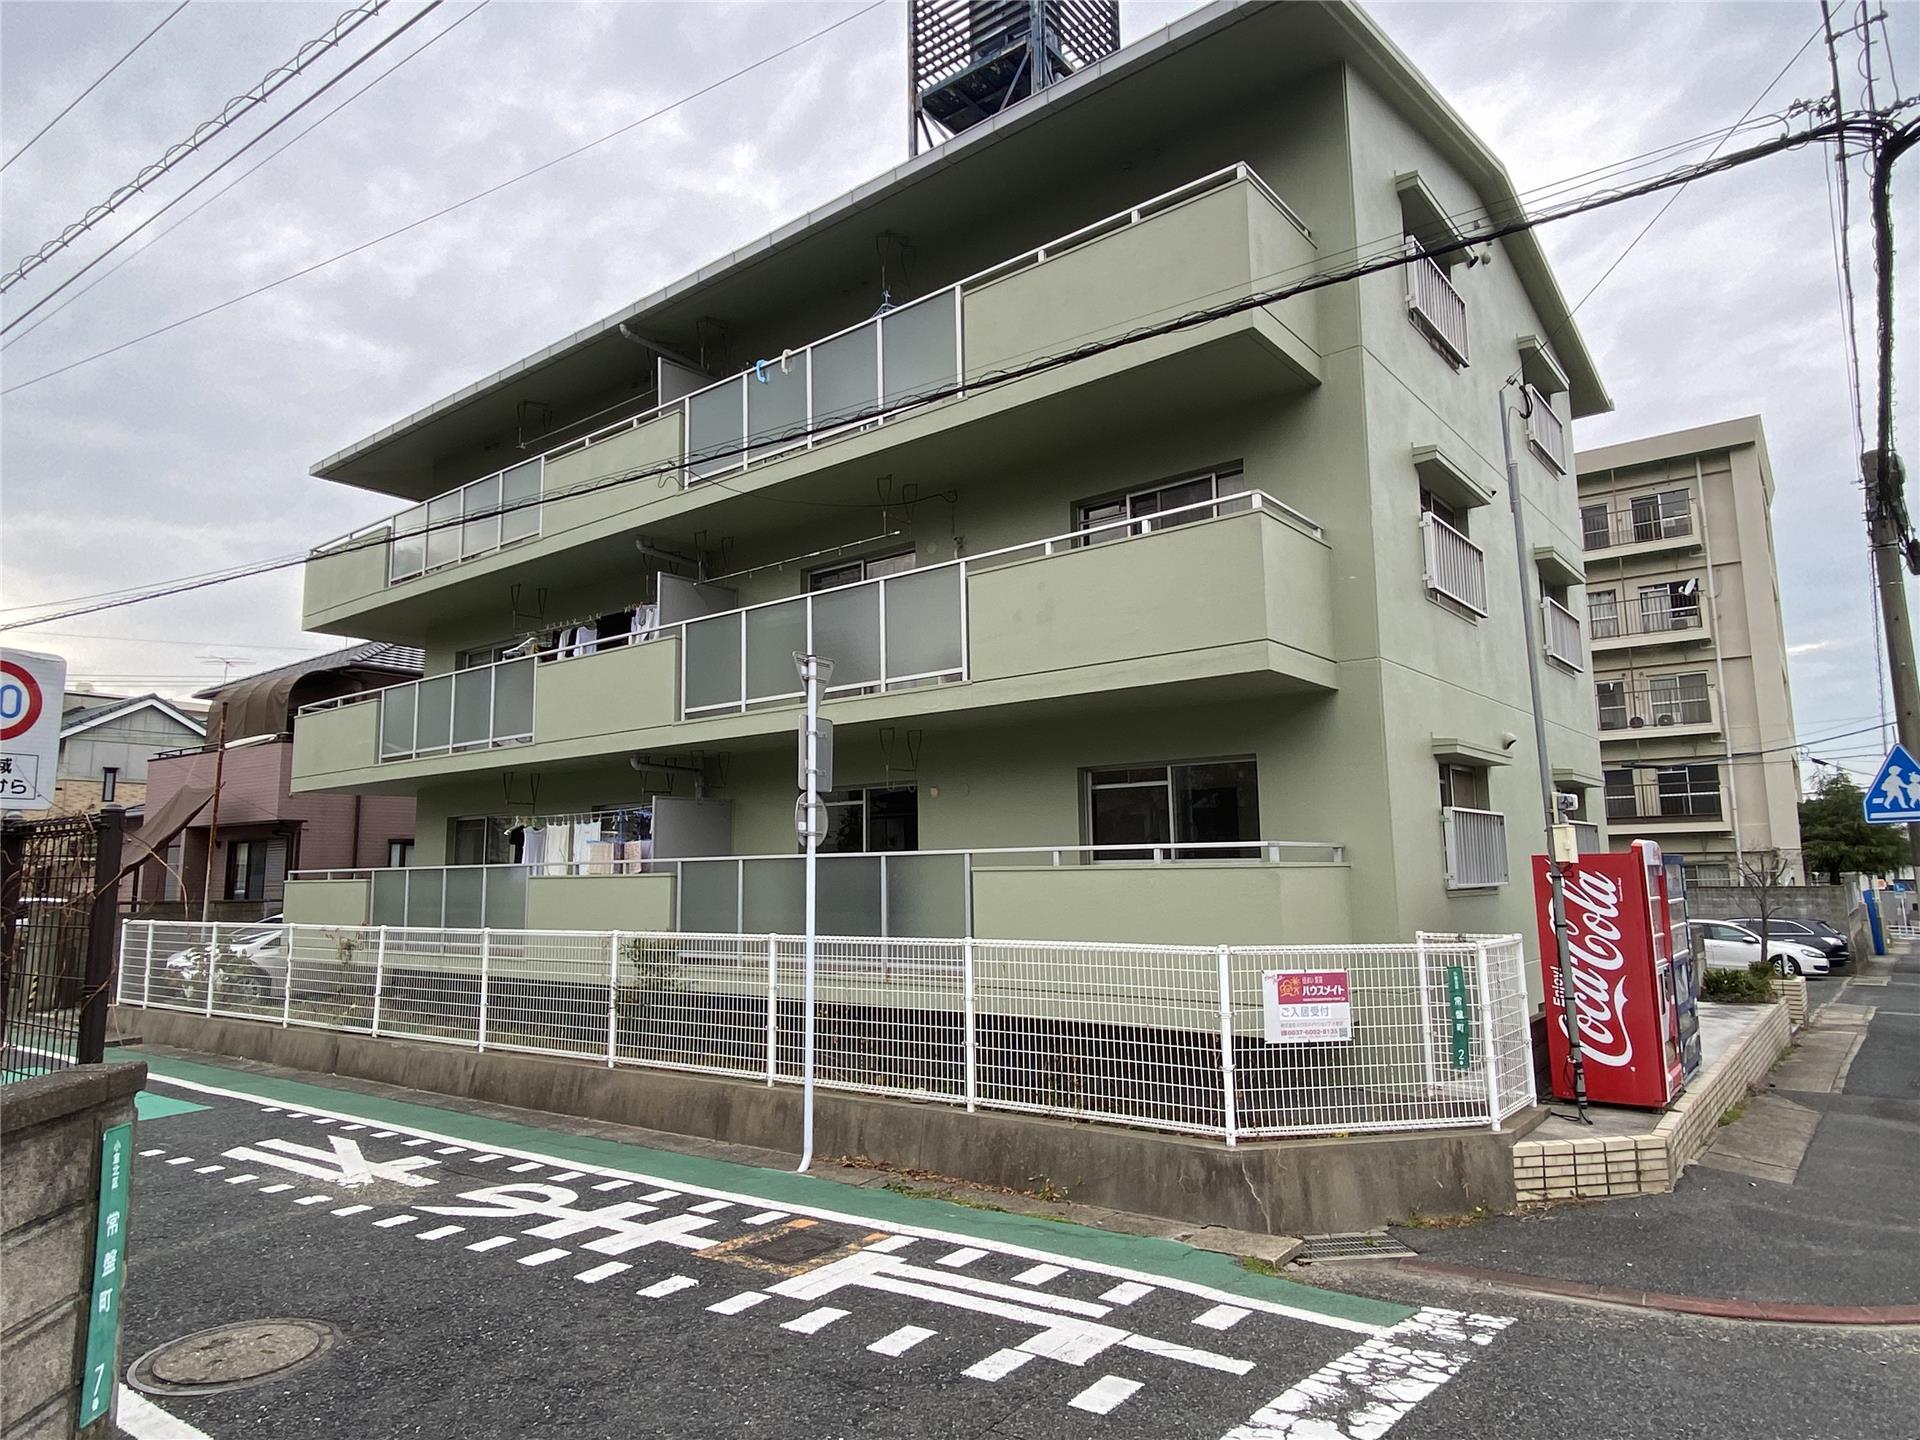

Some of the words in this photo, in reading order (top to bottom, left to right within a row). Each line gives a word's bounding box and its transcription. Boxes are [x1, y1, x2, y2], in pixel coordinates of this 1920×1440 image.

[1302, 984, 1345, 996] ハウスメイト
[1281, 1006, 1329, 1018] ご入居受付
[98, 1211, 121, 1313] 常盤町
